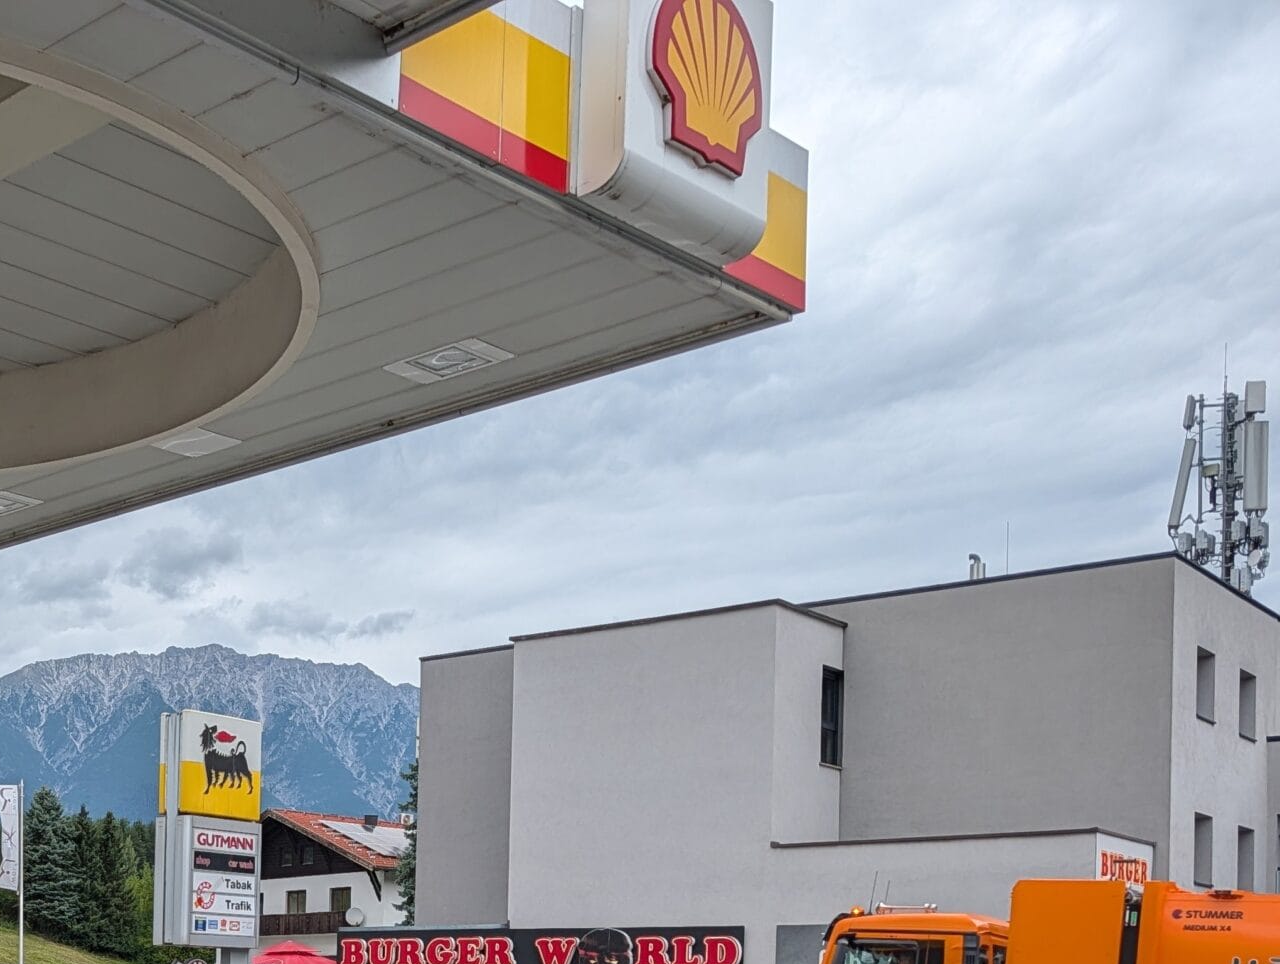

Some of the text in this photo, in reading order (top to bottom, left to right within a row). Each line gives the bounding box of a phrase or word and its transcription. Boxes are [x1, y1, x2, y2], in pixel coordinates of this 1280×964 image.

[197, 832, 254, 851] GUTMANN
[195, 855, 211, 868] shop
[1100, 850, 1148, 884] BURGER
[224, 878, 252, 890] Tabak
[224, 899, 252, 911] Trafik
[1185, 910, 1243, 920] STUMMER
